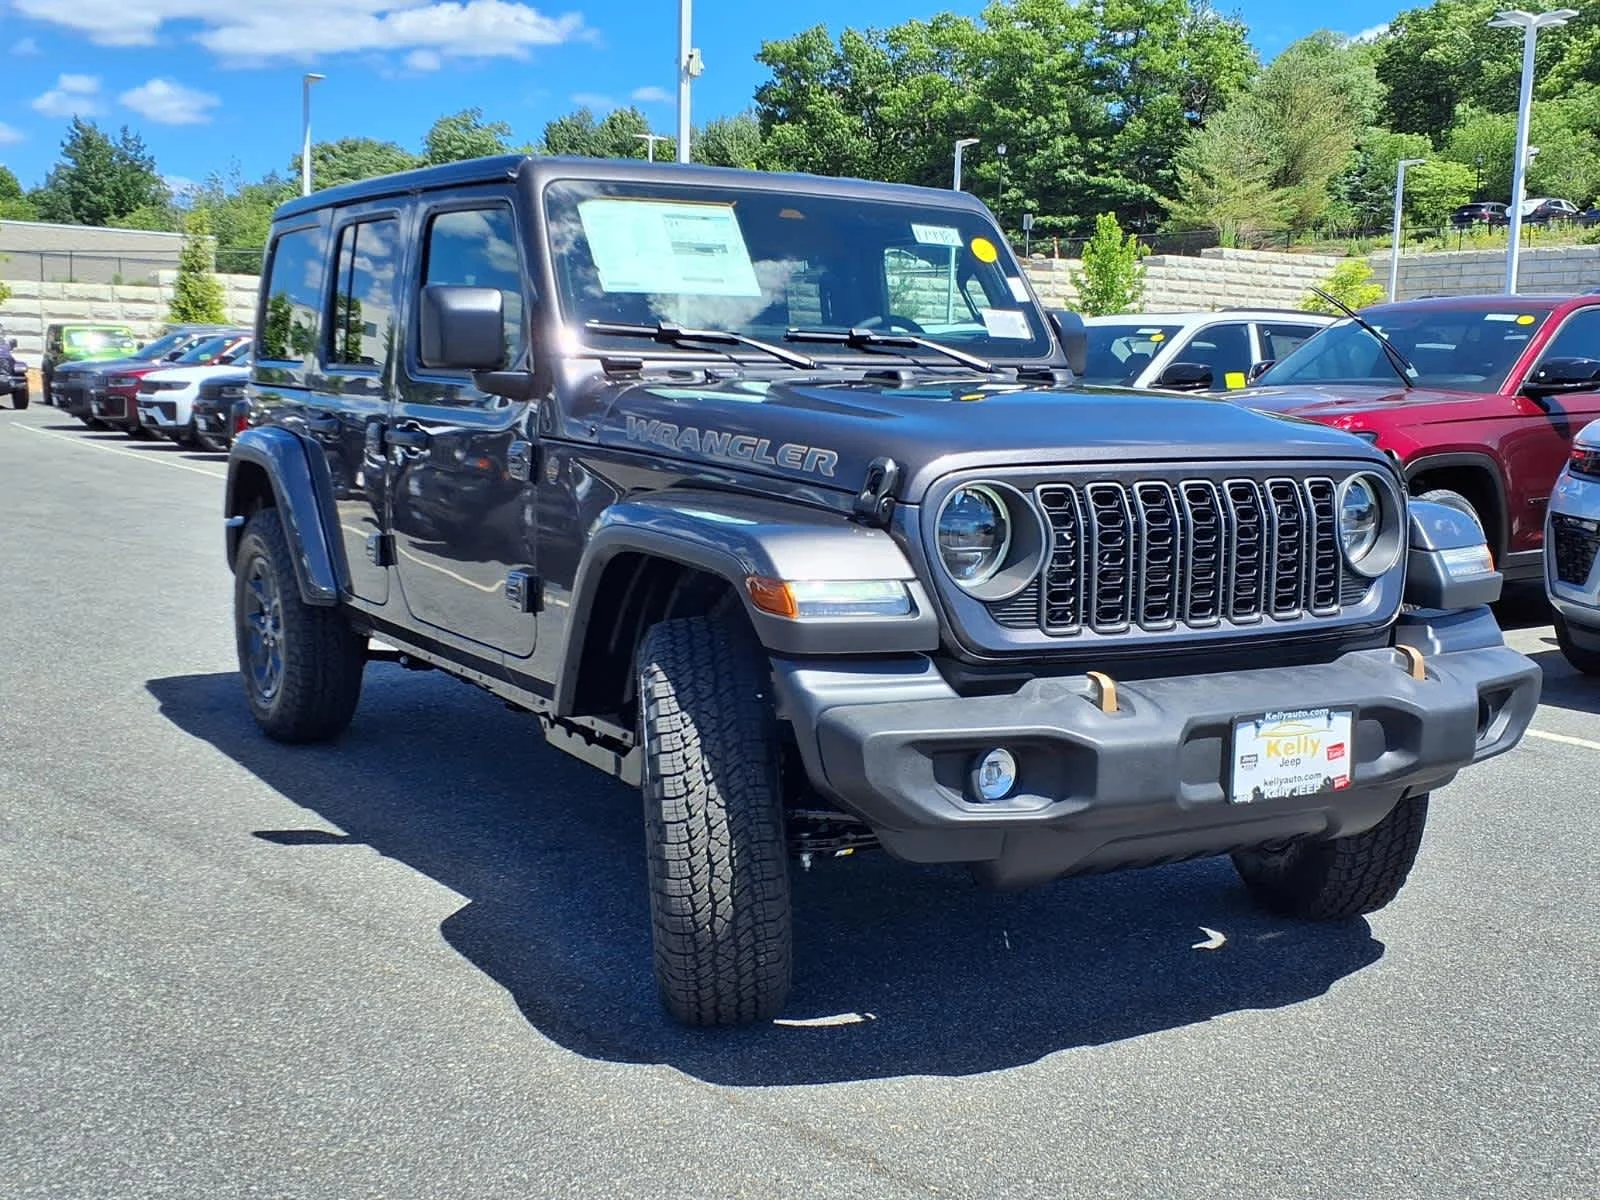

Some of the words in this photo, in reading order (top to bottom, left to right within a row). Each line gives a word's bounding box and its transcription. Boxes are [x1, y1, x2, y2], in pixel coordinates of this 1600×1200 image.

[625, 415, 839, 478] WRANGLER
[1266, 736, 1321, 758] Kelly
[1279, 757, 1301, 768] Jeep
[1263, 772, 1322, 787] kellyauto.com
